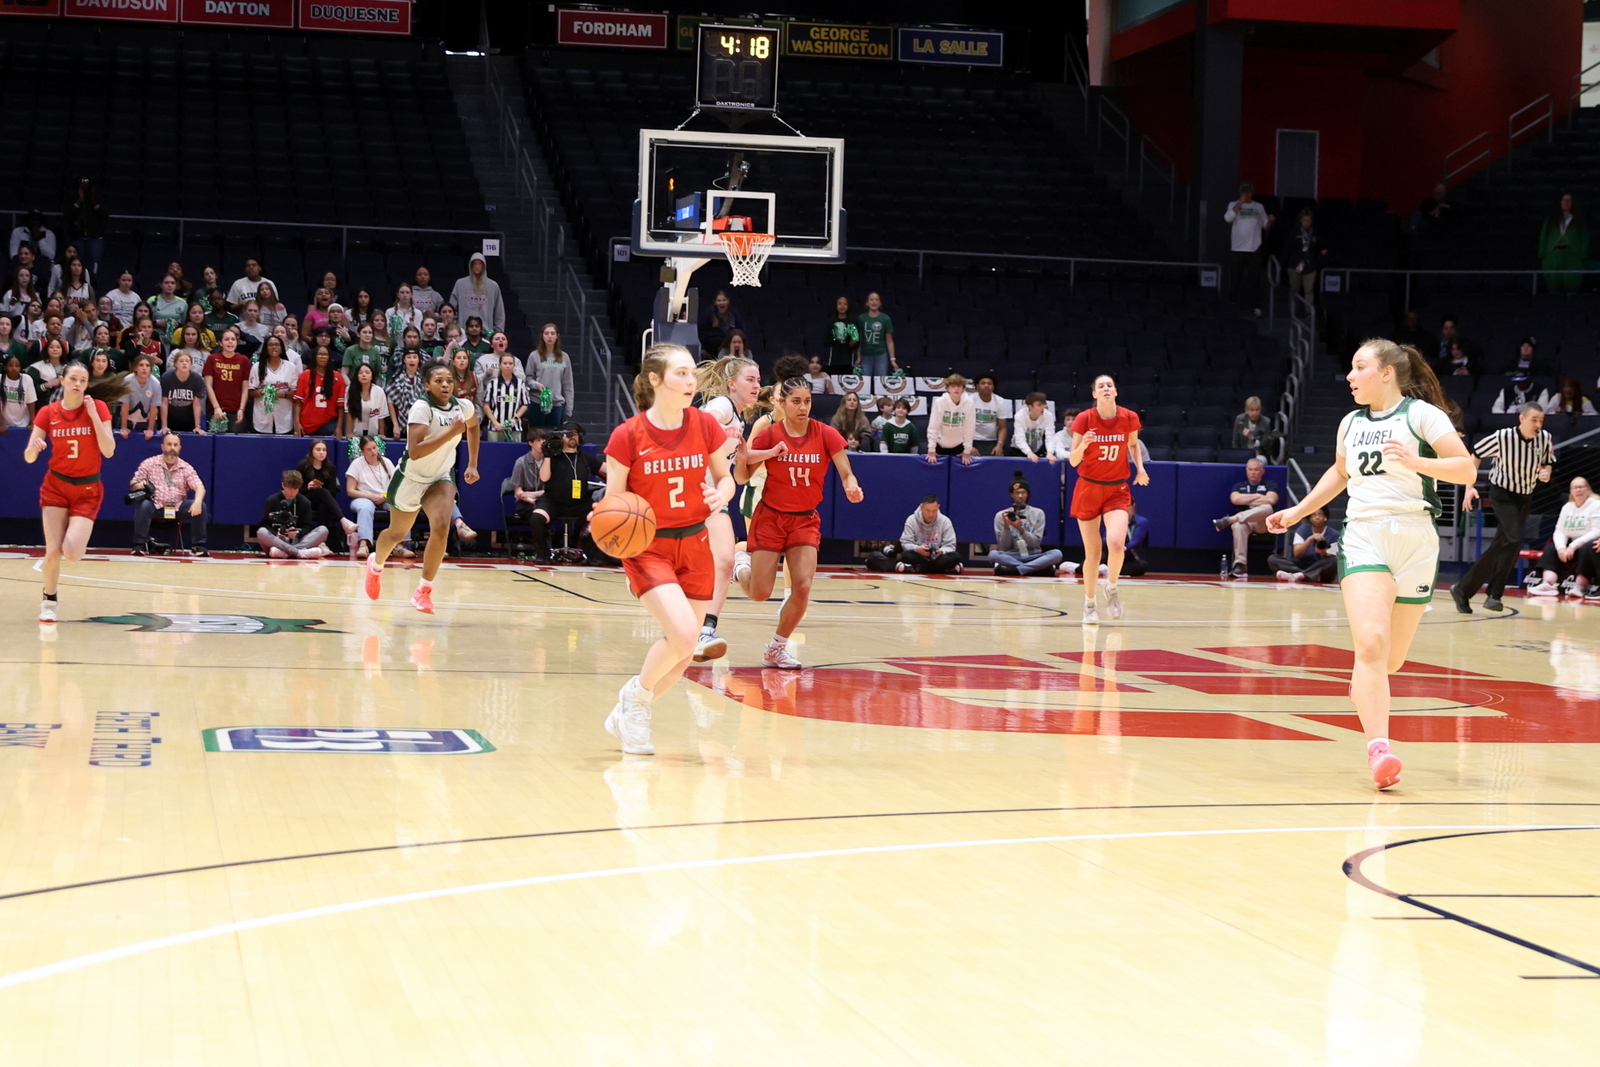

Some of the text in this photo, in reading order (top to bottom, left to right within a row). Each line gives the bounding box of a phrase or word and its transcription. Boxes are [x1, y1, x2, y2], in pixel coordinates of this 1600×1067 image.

[205, 1, 270, 17] DAYTON
[310, 4, 399, 23] DUQUESNE
[573, 21, 652, 37] FORDHAM
[809, 27, 870, 42] GEORGE
[720, 35, 770, 59] 4:18
[791, 39, 889, 57] WASHINGTON
[913, 38, 988, 56] LA SALLE
[716, 100, 756, 108] DAKTRONICS
[215, 362, 241, 371] CLEVELAND
[220, 370, 233, 382] 31
[52, 426, 92, 438] BELLEVUE
[66, 439, 80, 459] 3
[1097, 444, 1120, 462] 30
[643, 453, 704, 476] BELLEVUE
[1357, 450, 1387, 476] 22
[788, 466, 811, 487] 14
[667, 476, 686, 509] 2
